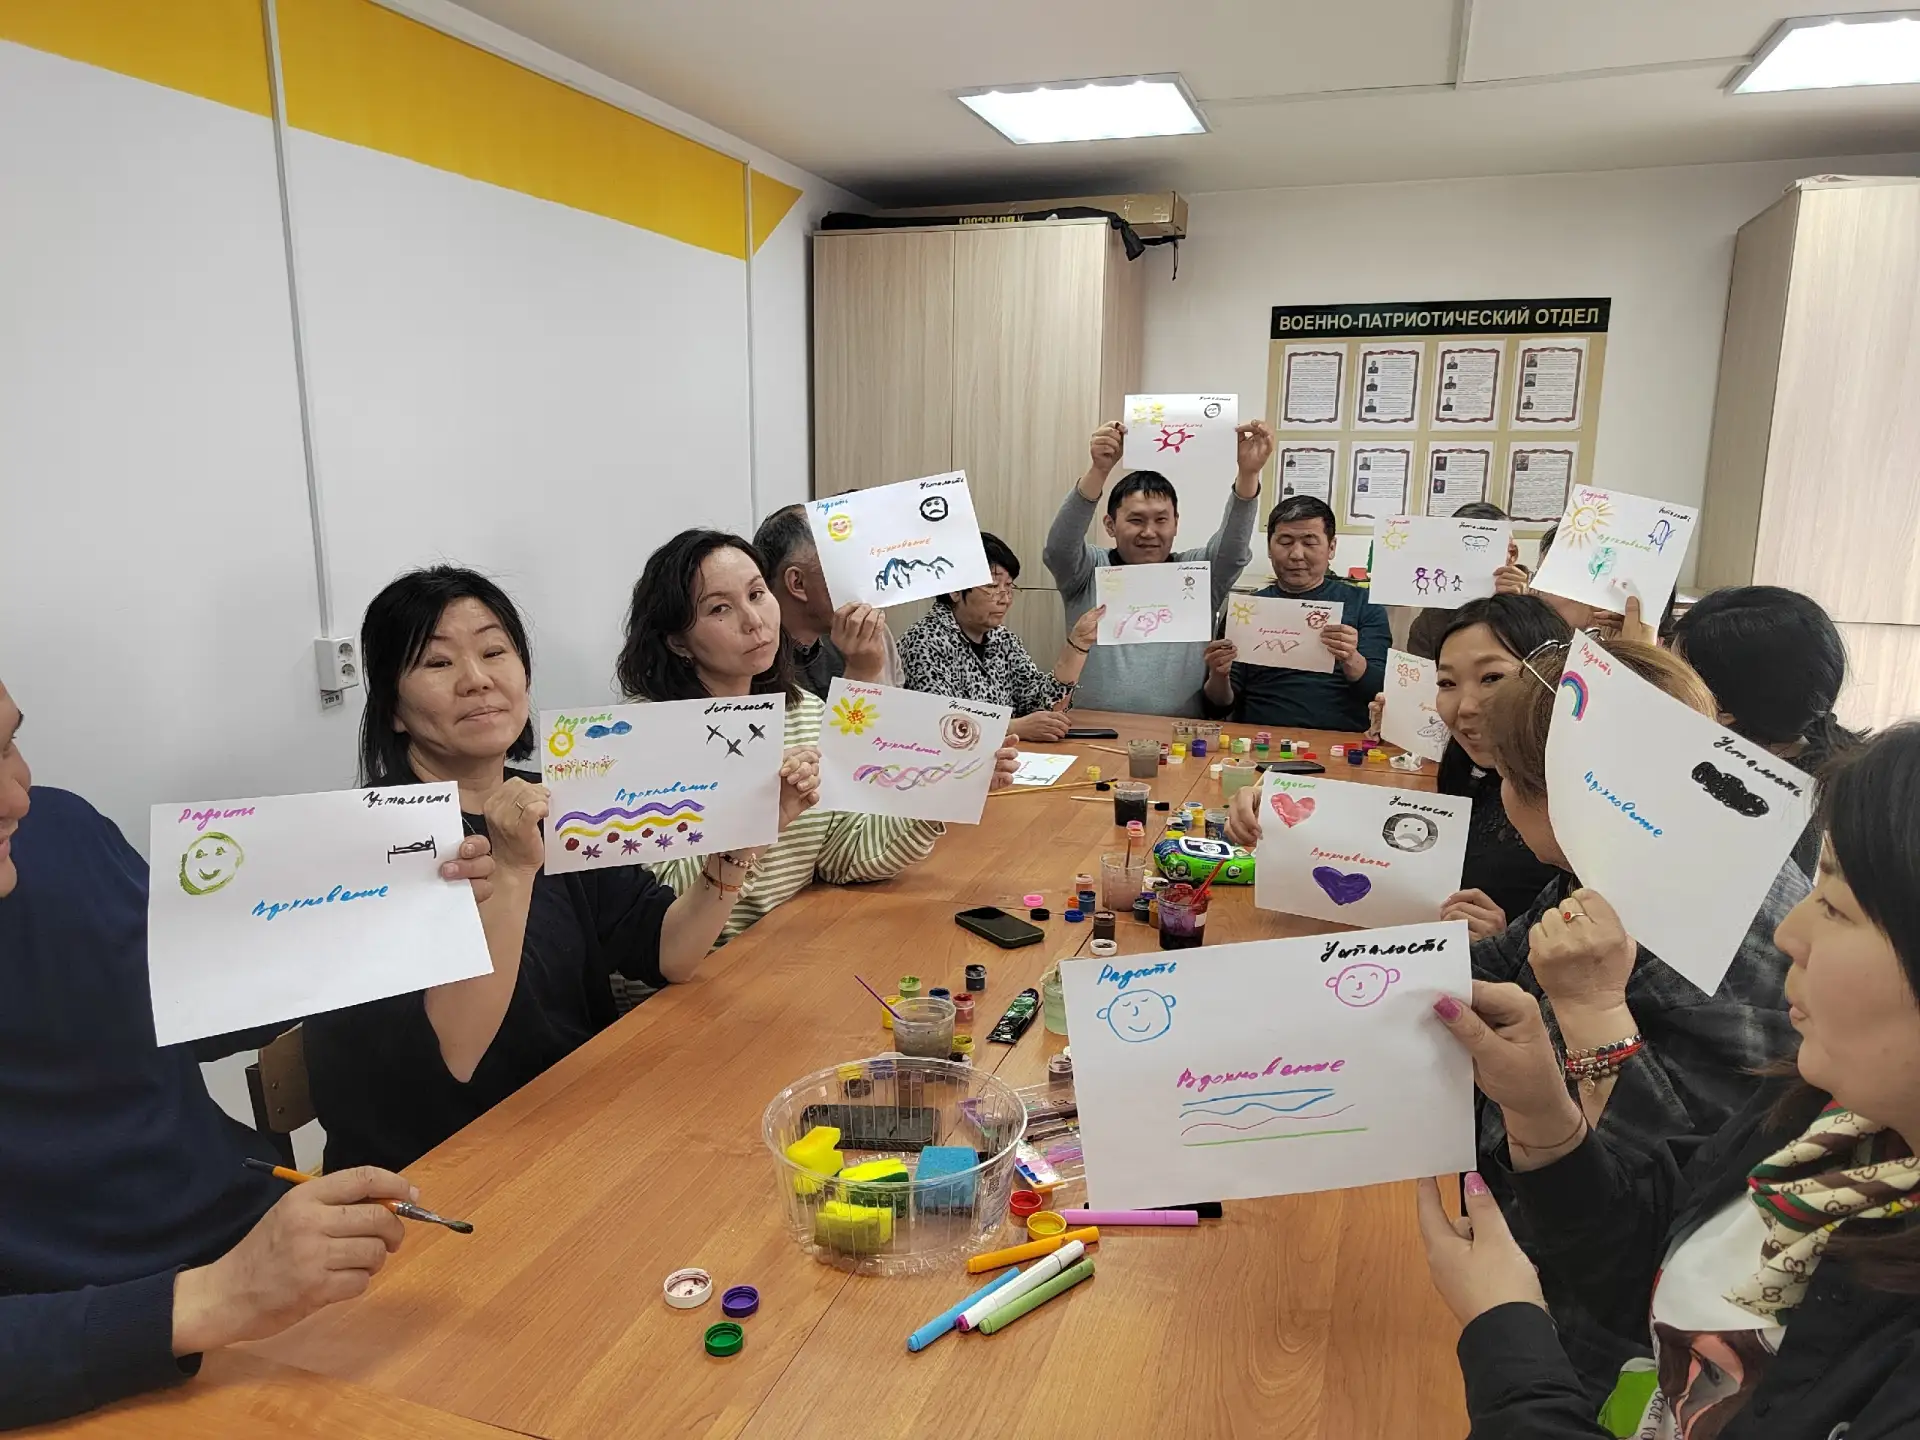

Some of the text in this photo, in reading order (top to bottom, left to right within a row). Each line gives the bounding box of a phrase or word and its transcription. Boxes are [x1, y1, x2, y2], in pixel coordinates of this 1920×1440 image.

[1278, 306, 1600, 331] ВОЕННО-ПАТРИОТИЧЕСКИЙ ОТДЕЛ
[1580, 643, 1612, 676] Радость
[555, 713, 613, 731] Радость
[1713, 736, 1803, 797] Усталость
[614, 781, 719, 806] Вдохновение
[1273, 778, 1317, 790] Радость
[363, 791, 452, 807] Усталость
[1584, 771, 1663, 838] Вдохновение
[178, 807, 255, 831] Радость
[252, 885, 388, 921] Вдохновение
[1321, 938, 1448, 962] Усталость
[1097, 961, 1177, 987] Радость
[1177, 1057, 1346, 1092] Вдохновение
[1646, 1389, 1666, 1423] OGUE
